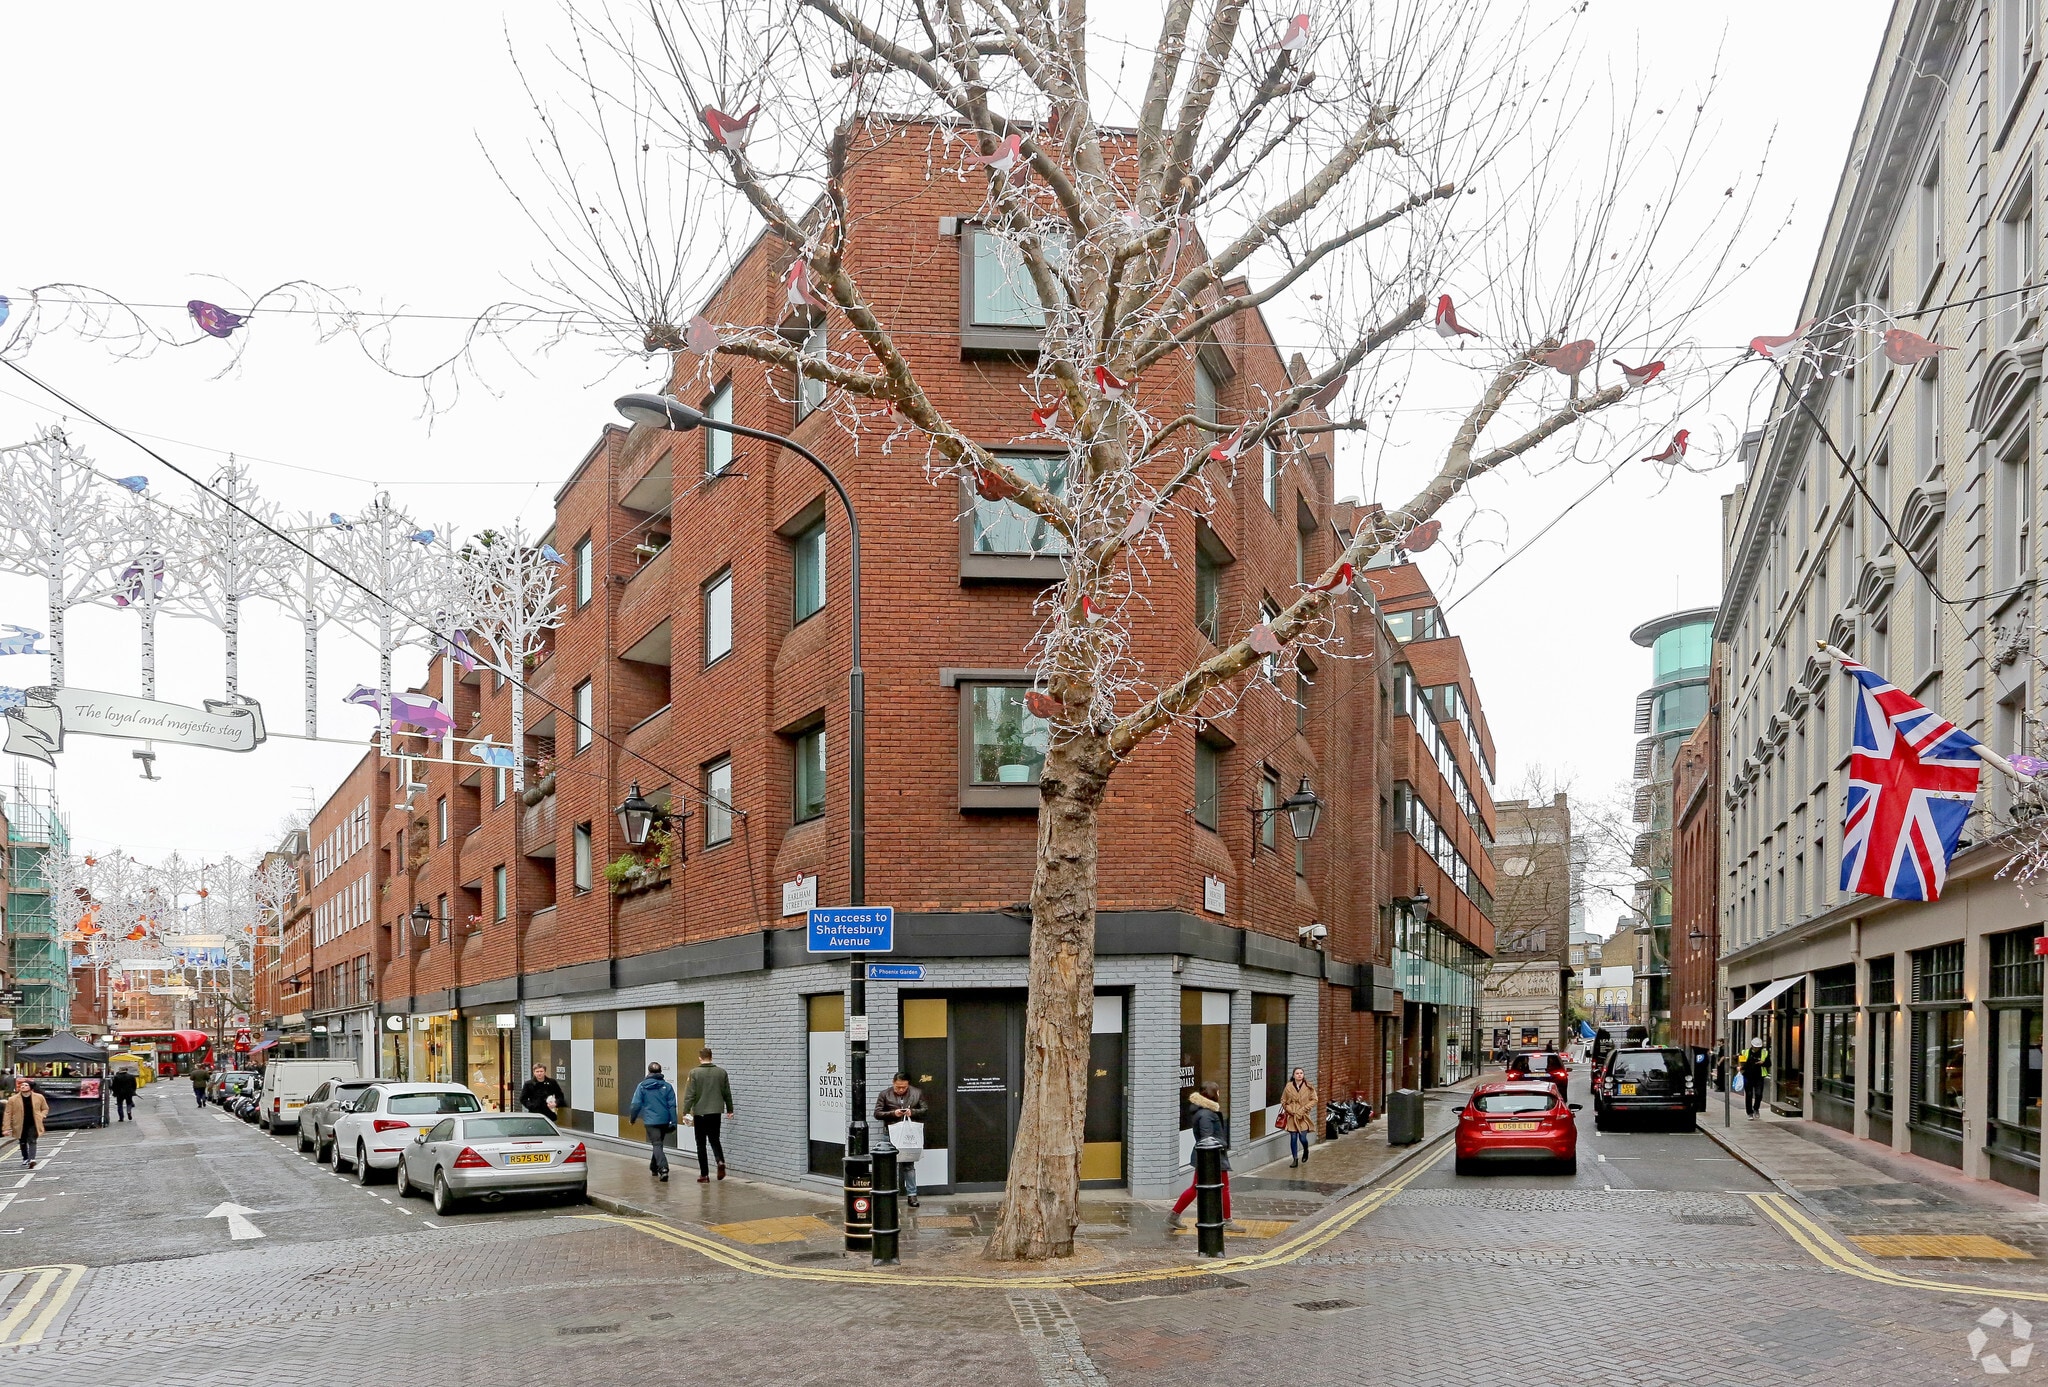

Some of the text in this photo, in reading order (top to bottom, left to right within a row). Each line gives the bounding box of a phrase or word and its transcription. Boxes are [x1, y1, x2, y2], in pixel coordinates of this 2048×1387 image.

[75, 703, 243, 743] The loyal and majestic stag
[787, 889, 811, 902] EARLHAM
[785, 899, 803, 911] STREET
[813, 912, 888, 923] No access to
[816, 925, 885, 936] Shaftesbury
[829, 937, 871, 947] Avenue
[899, 968, 918, 976] Garden
[598, 1065, 612, 1076] SHOP
[1179, 1066, 1195, 1077] SEVEN
[1249, 1068, 1264, 1082] O LET
[597, 1077, 615, 1089] TO LET
[819, 1075, 844, 1087] SEVEN
[1179, 1077, 1195, 1088] DIALS
[819, 1087, 844, 1098] DIALS
[819, 1100, 844, 1108] LONDON
[510, 1154, 532, 1163] R575
[852, 1178, 871, 1188] Litter
